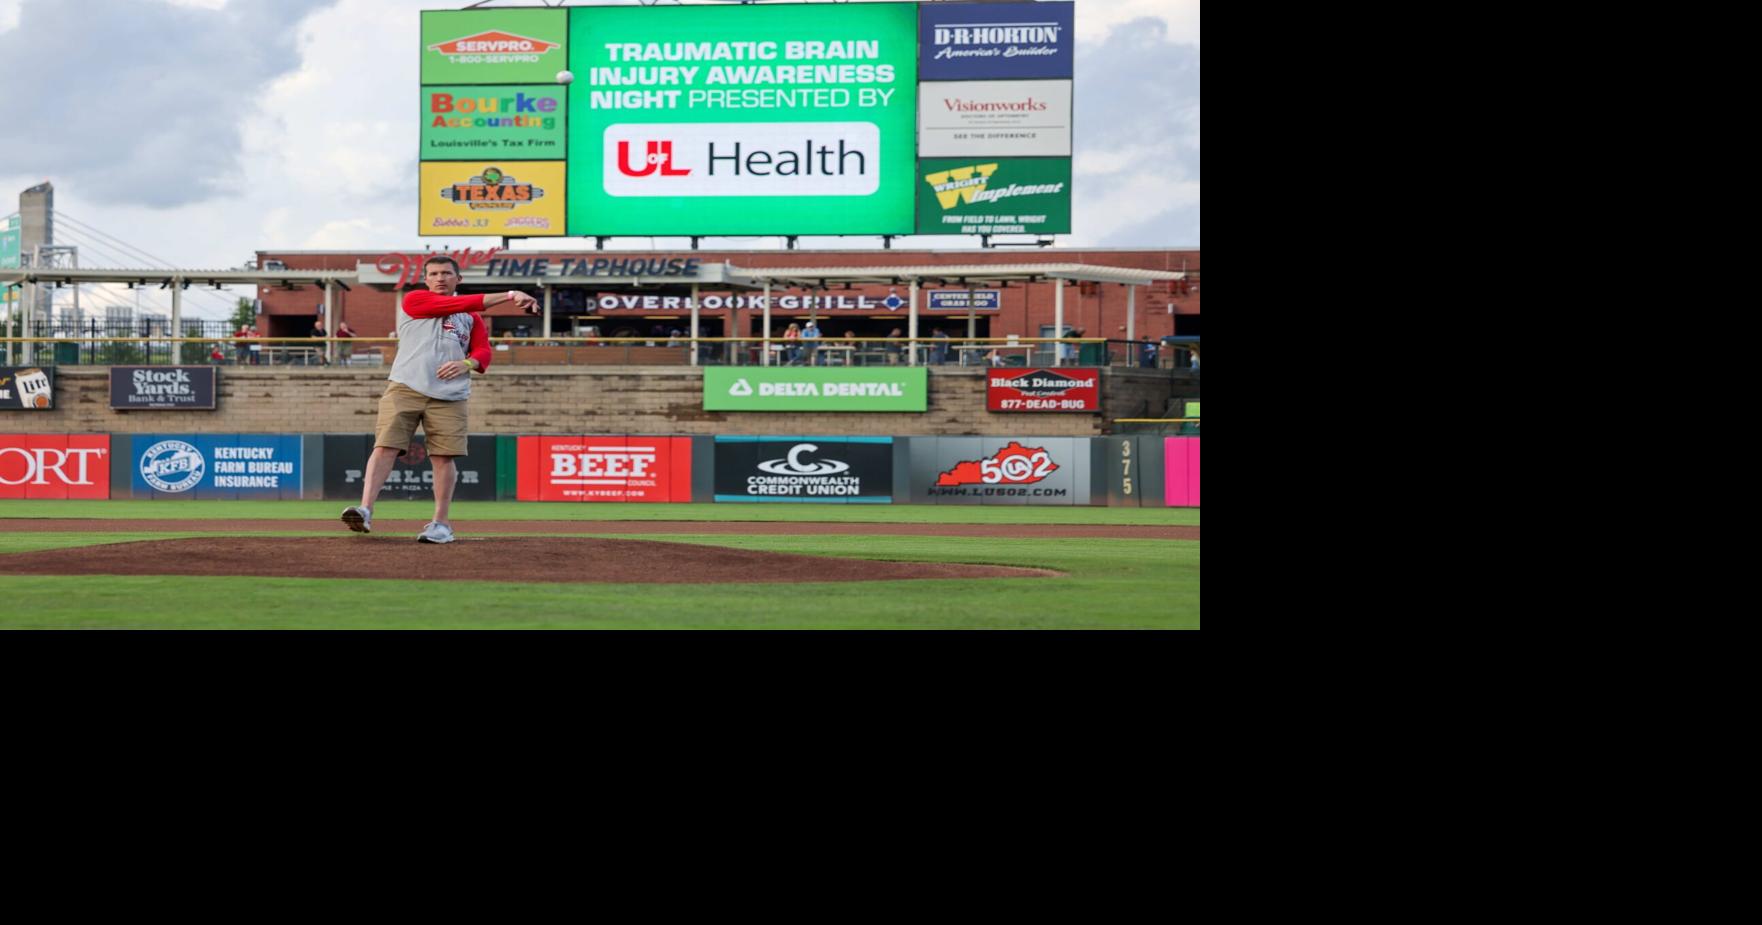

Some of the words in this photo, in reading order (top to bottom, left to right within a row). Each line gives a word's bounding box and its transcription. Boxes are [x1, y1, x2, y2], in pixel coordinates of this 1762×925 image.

[605, 41, 778, 61] TRAUMATIC
[785, 40, 879, 60] BRAIN
[934, 46, 1001, 60] America's
[1003, 45, 1058, 58] Builder
[449, 55, 539, 64] 1-800-SERVPRO
[590, 66, 699, 86] INJURY
[705, 64, 895, 85] AWARENESS
[431, 92, 558, 114] Bourke
[590, 90, 682, 109] NIGHT
[689, 88, 850, 109] PRESENTED
[859, 87, 895, 107] BY
[944, 97, 1047, 112] Visionworks
[432, 115, 556, 130] Accounting
[431, 139, 498, 148] Louisville's
[502, 139, 523, 147] Tax
[527, 139, 556, 147] Firm
[708, 139, 866, 176] Health
[933, 176, 990, 193] WRIGHT
[456, 184, 531, 201] TEXAS
[486, 258, 549, 277] TIME
[559, 257, 701, 277] TAPHOUSE
[600, 295, 766, 310] OVERLOOK
[779, 295, 875, 309] GRILL
[132, 369, 190, 382] Stock
[991, 378, 1028, 387] Black
[1032, 378, 1093, 387] Diamond
[759, 383, 819, 396] DELTA
[823, 383, 902, 396] DENTAL
[1001, 400, 1085, 409] 877-DEAD-BUG
[147, 441, 193, 458] KENTUCKY
[214, 448, 274, 459] KENTUCKY
[159, 458, 188, 474] KFB
[214, 461, 245, 473] FARM
[248, 462, 293, 473] BUREAU
[214, 476, 279, 487] INSURANCE
[747, 476, 859, 485] COMMONWEALTH
[747, 485, 803, 495] CREDIT
[806, 485, 859, 495] UNION
[927, 487, 1066, 496] WWW.LU502.COM
